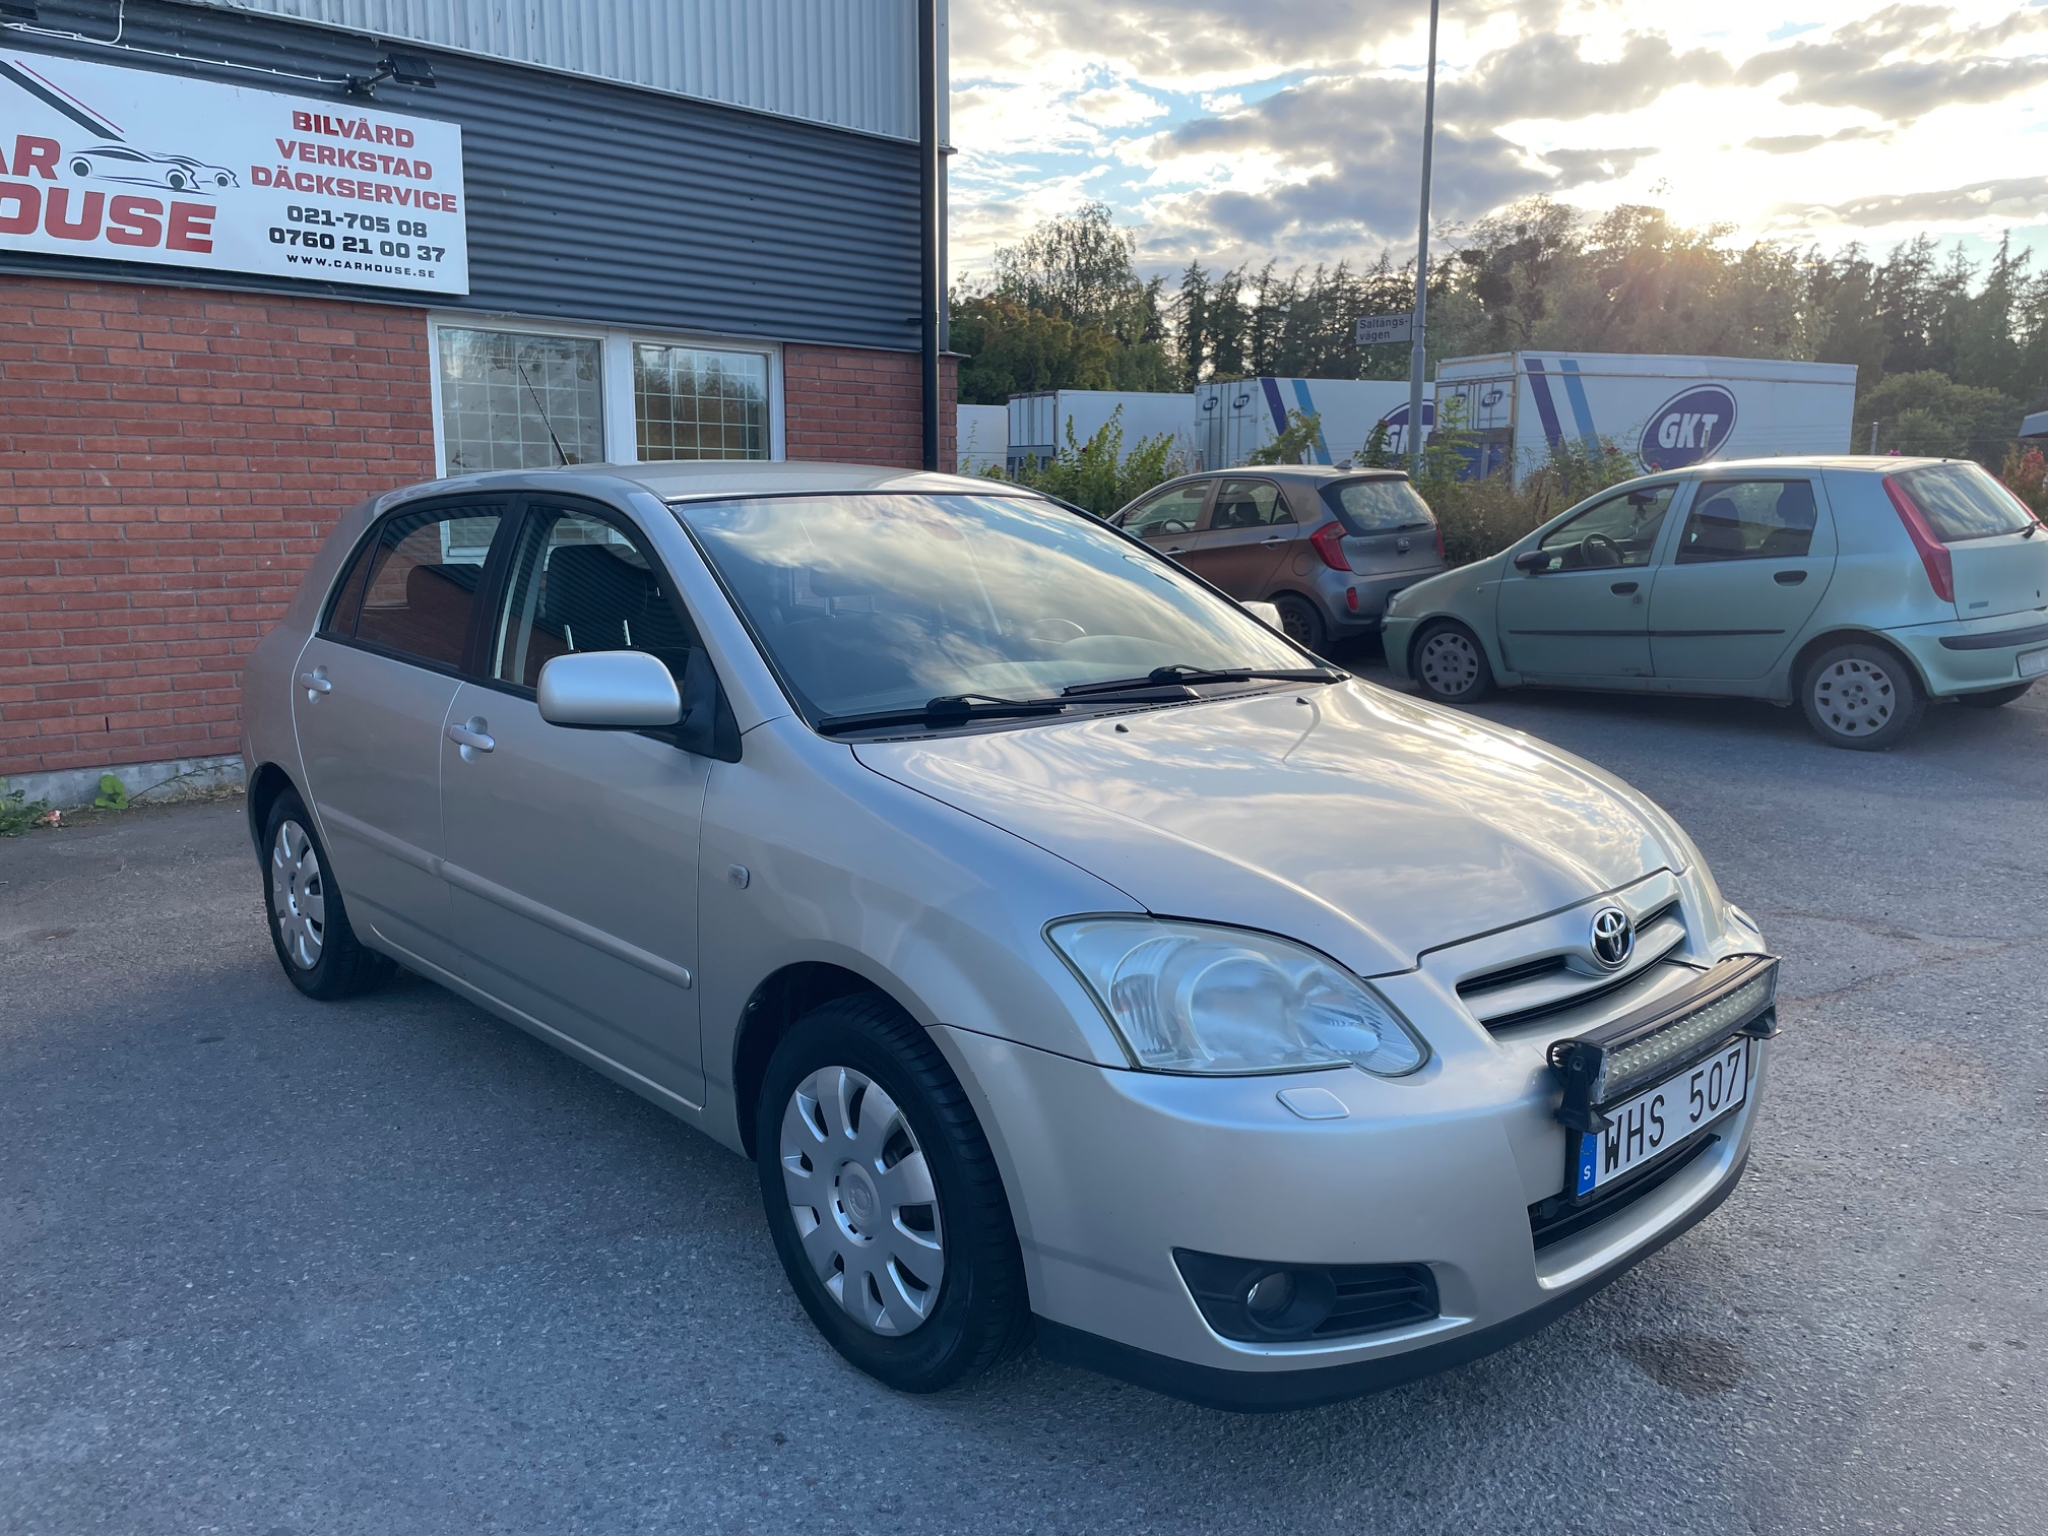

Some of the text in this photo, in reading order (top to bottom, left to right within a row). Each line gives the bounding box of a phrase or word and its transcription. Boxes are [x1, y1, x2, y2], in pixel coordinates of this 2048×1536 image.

[292, 110, 414, 148] BILVÅRD
[0, 134, 61, 180] R
[275, 138, 433, 181] VERKSTAD
[251, 165, 458, 213] DÄCKSERVICE
[287, 205, 428, 238] 021-705 08
[269, 227, 446, 263] 0760 21 00 37
[286, 254, 435, 279] WWW.CARHOUSE.SE
[1658, 412, 1719, 449] GKT
[1604, 1047, 1742, 1174] WHS 507
[1583, 1164, 1592, 1181] S
